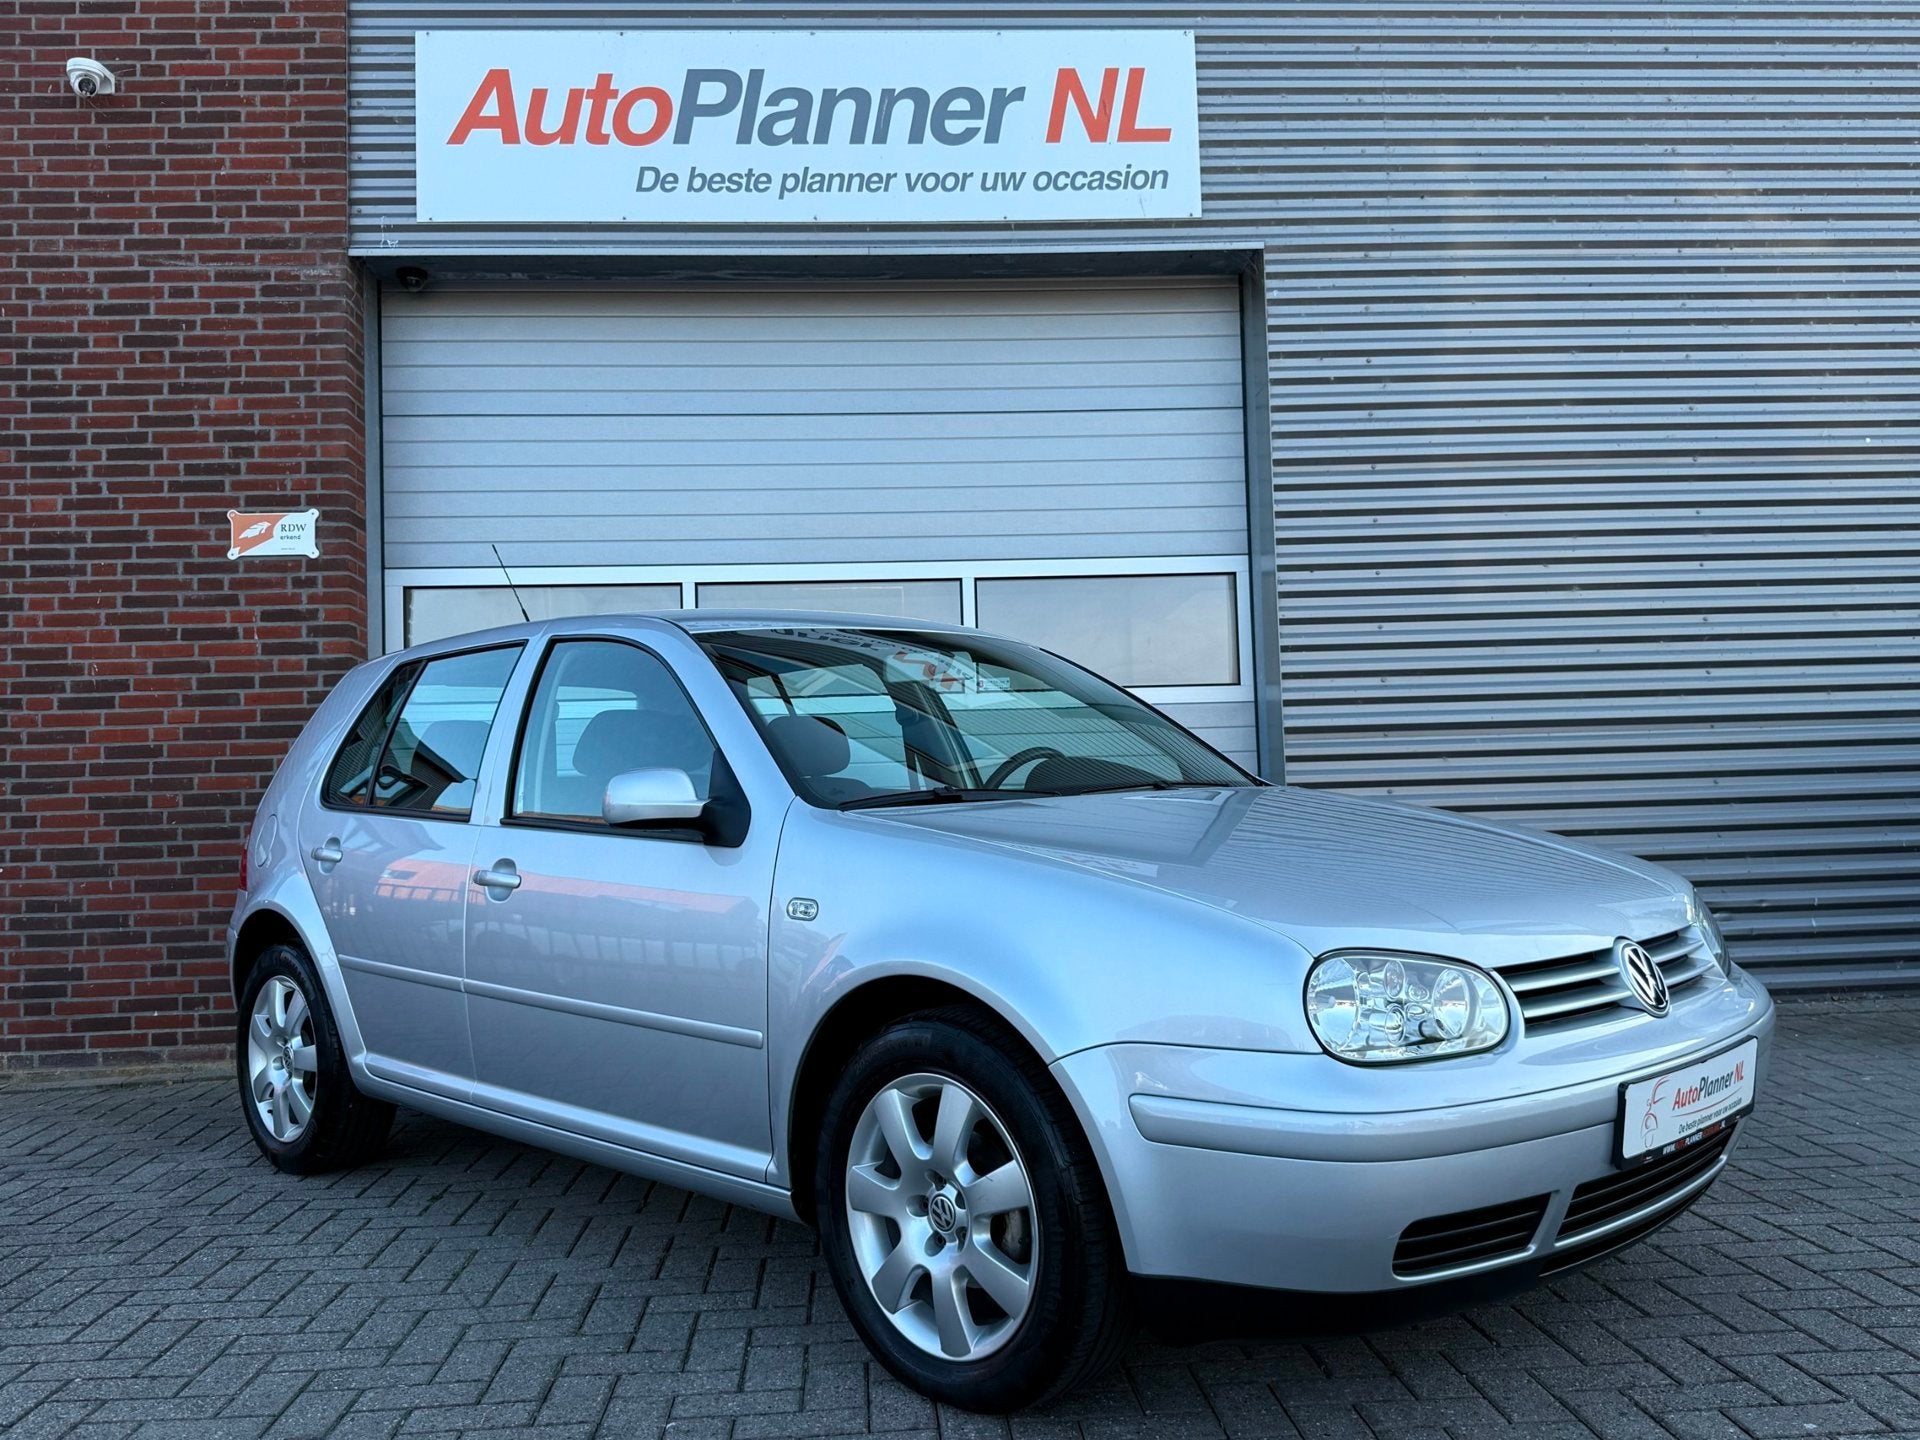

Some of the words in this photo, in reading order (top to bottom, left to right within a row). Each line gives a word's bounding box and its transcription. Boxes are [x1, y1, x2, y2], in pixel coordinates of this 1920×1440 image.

[446, 67, 1026, 147] AutoPlanner
[1045, 66, 1172, 144] NL
[635, 165, 679, 194] De
[686, 166, 772, 194] beste
[778, 166, 898, 201] planner
[904, 171, 974, 194] voor
[980, 170, 1027, 193] uw
[1032, 163, 1169, 193] occasion
[280, 523, 307, 533] RDW
[1672, 1071, 1734, 1111] AutoPlanner
[1734, 1060, 1744, 1084] NL
